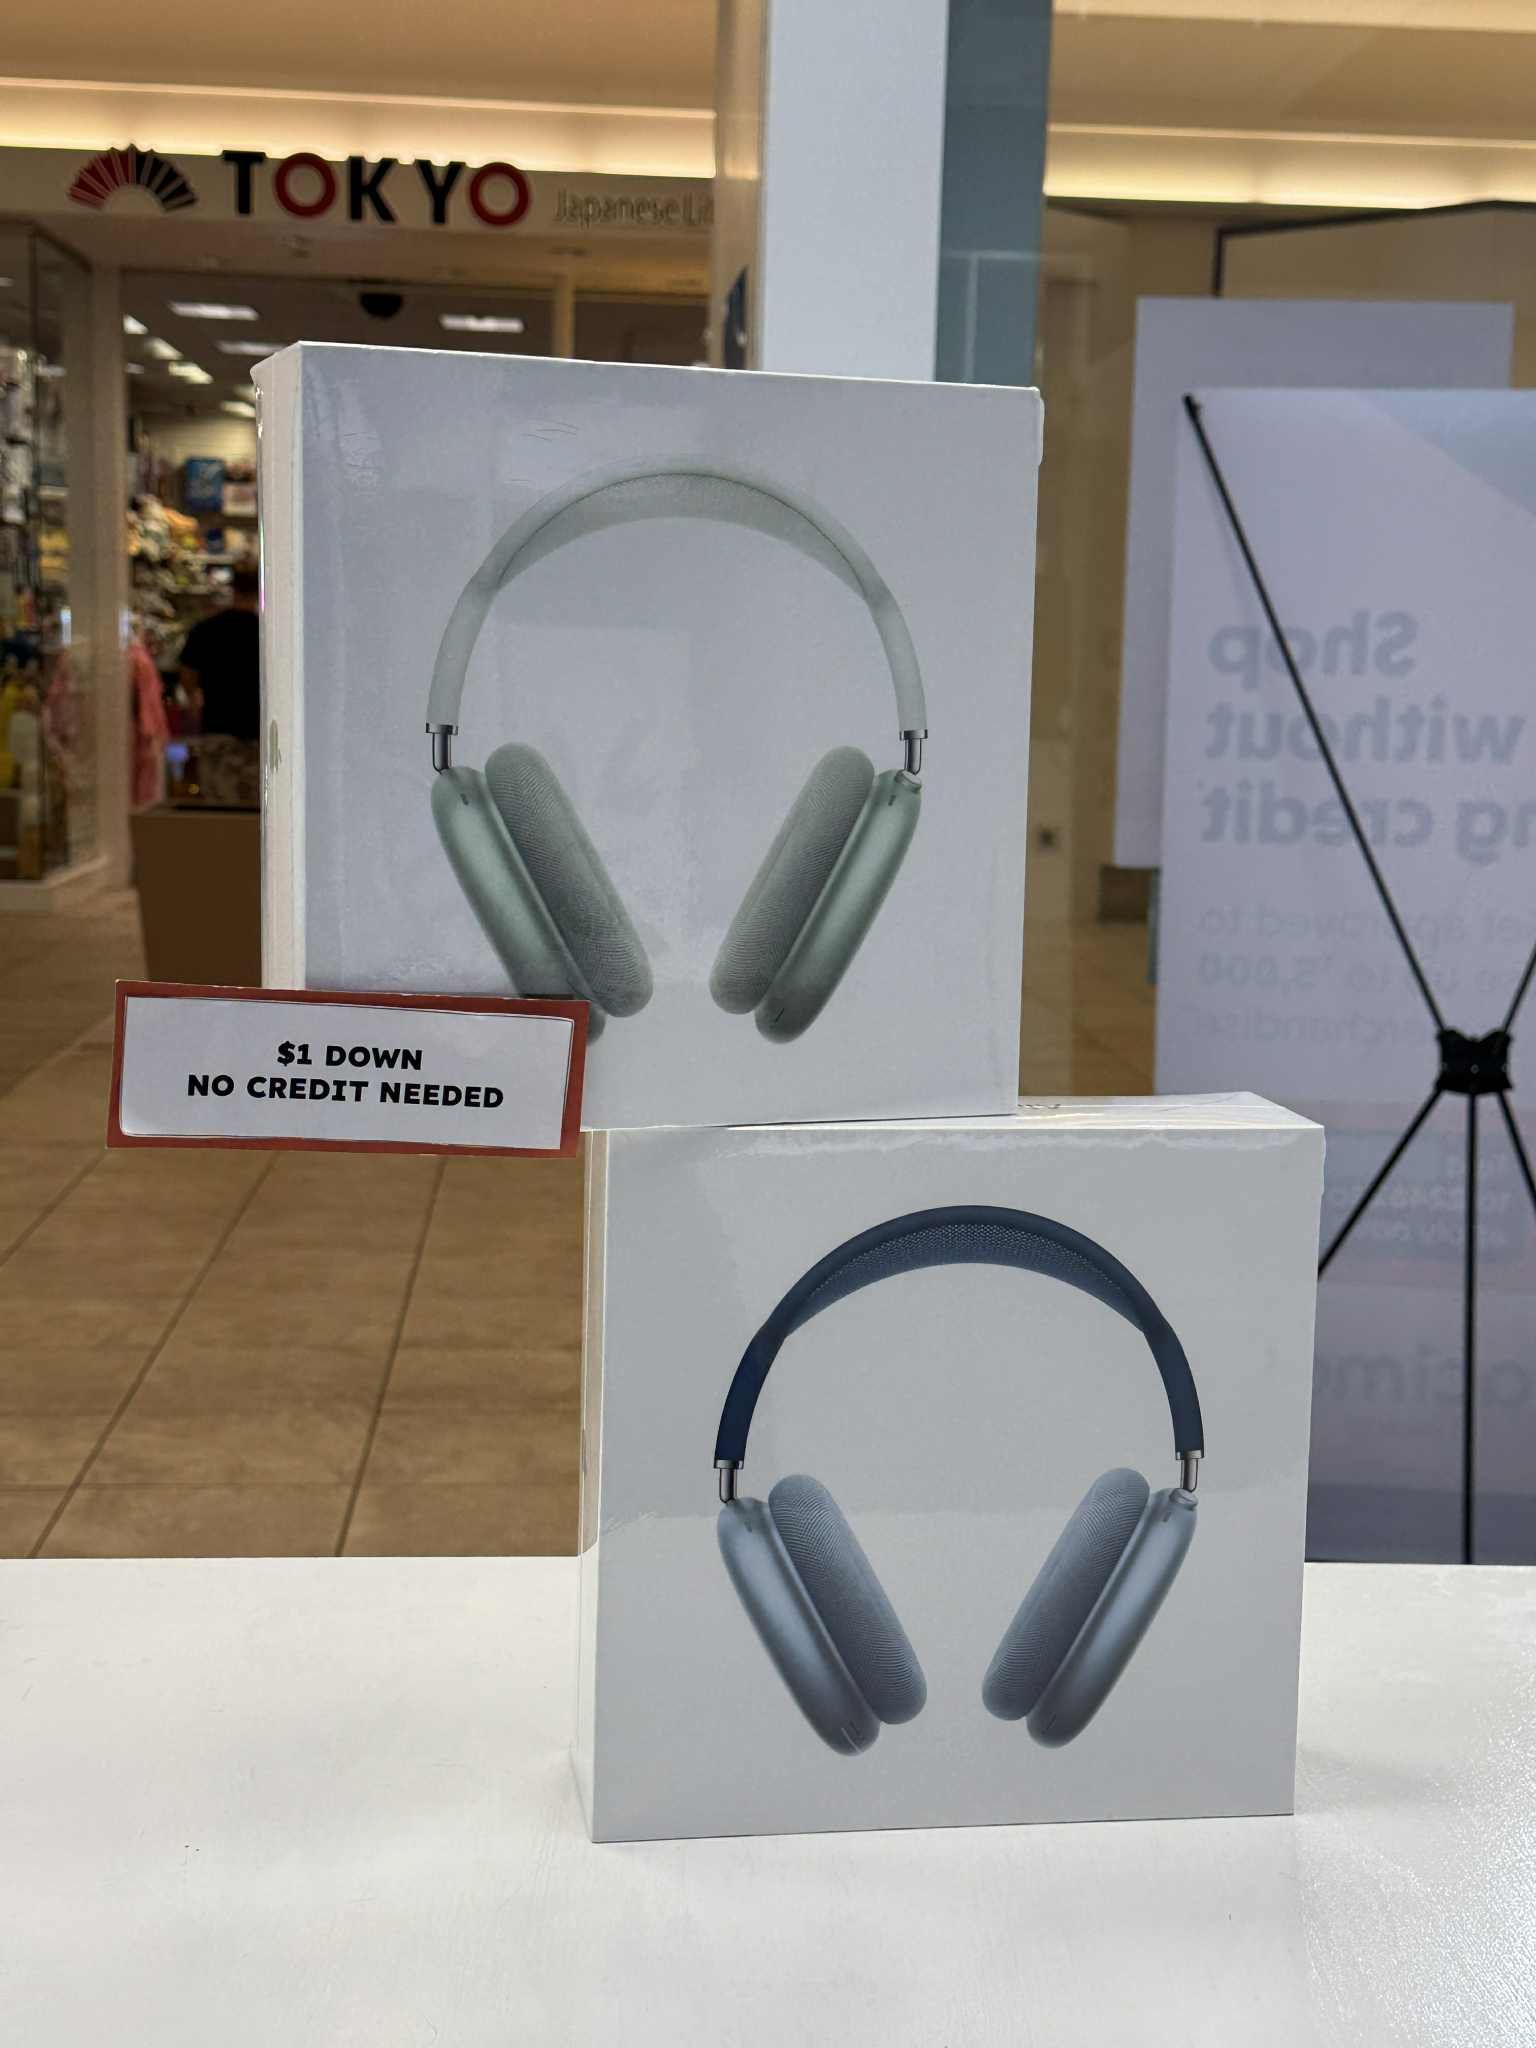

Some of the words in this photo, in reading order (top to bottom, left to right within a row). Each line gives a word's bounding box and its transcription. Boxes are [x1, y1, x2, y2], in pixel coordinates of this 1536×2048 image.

[221, 150, 530, 226] TOKYO
[553, 186, 680, 229] Japanese
[277, 1041, 312, 1068] $1
[325, 1045, 423, 1070] DOWN
[187, 1074, 235, 1098] NO
[246, 1076, 369, 1104] CREDIT
[379, 1081, 505, 1109] NEEDED
